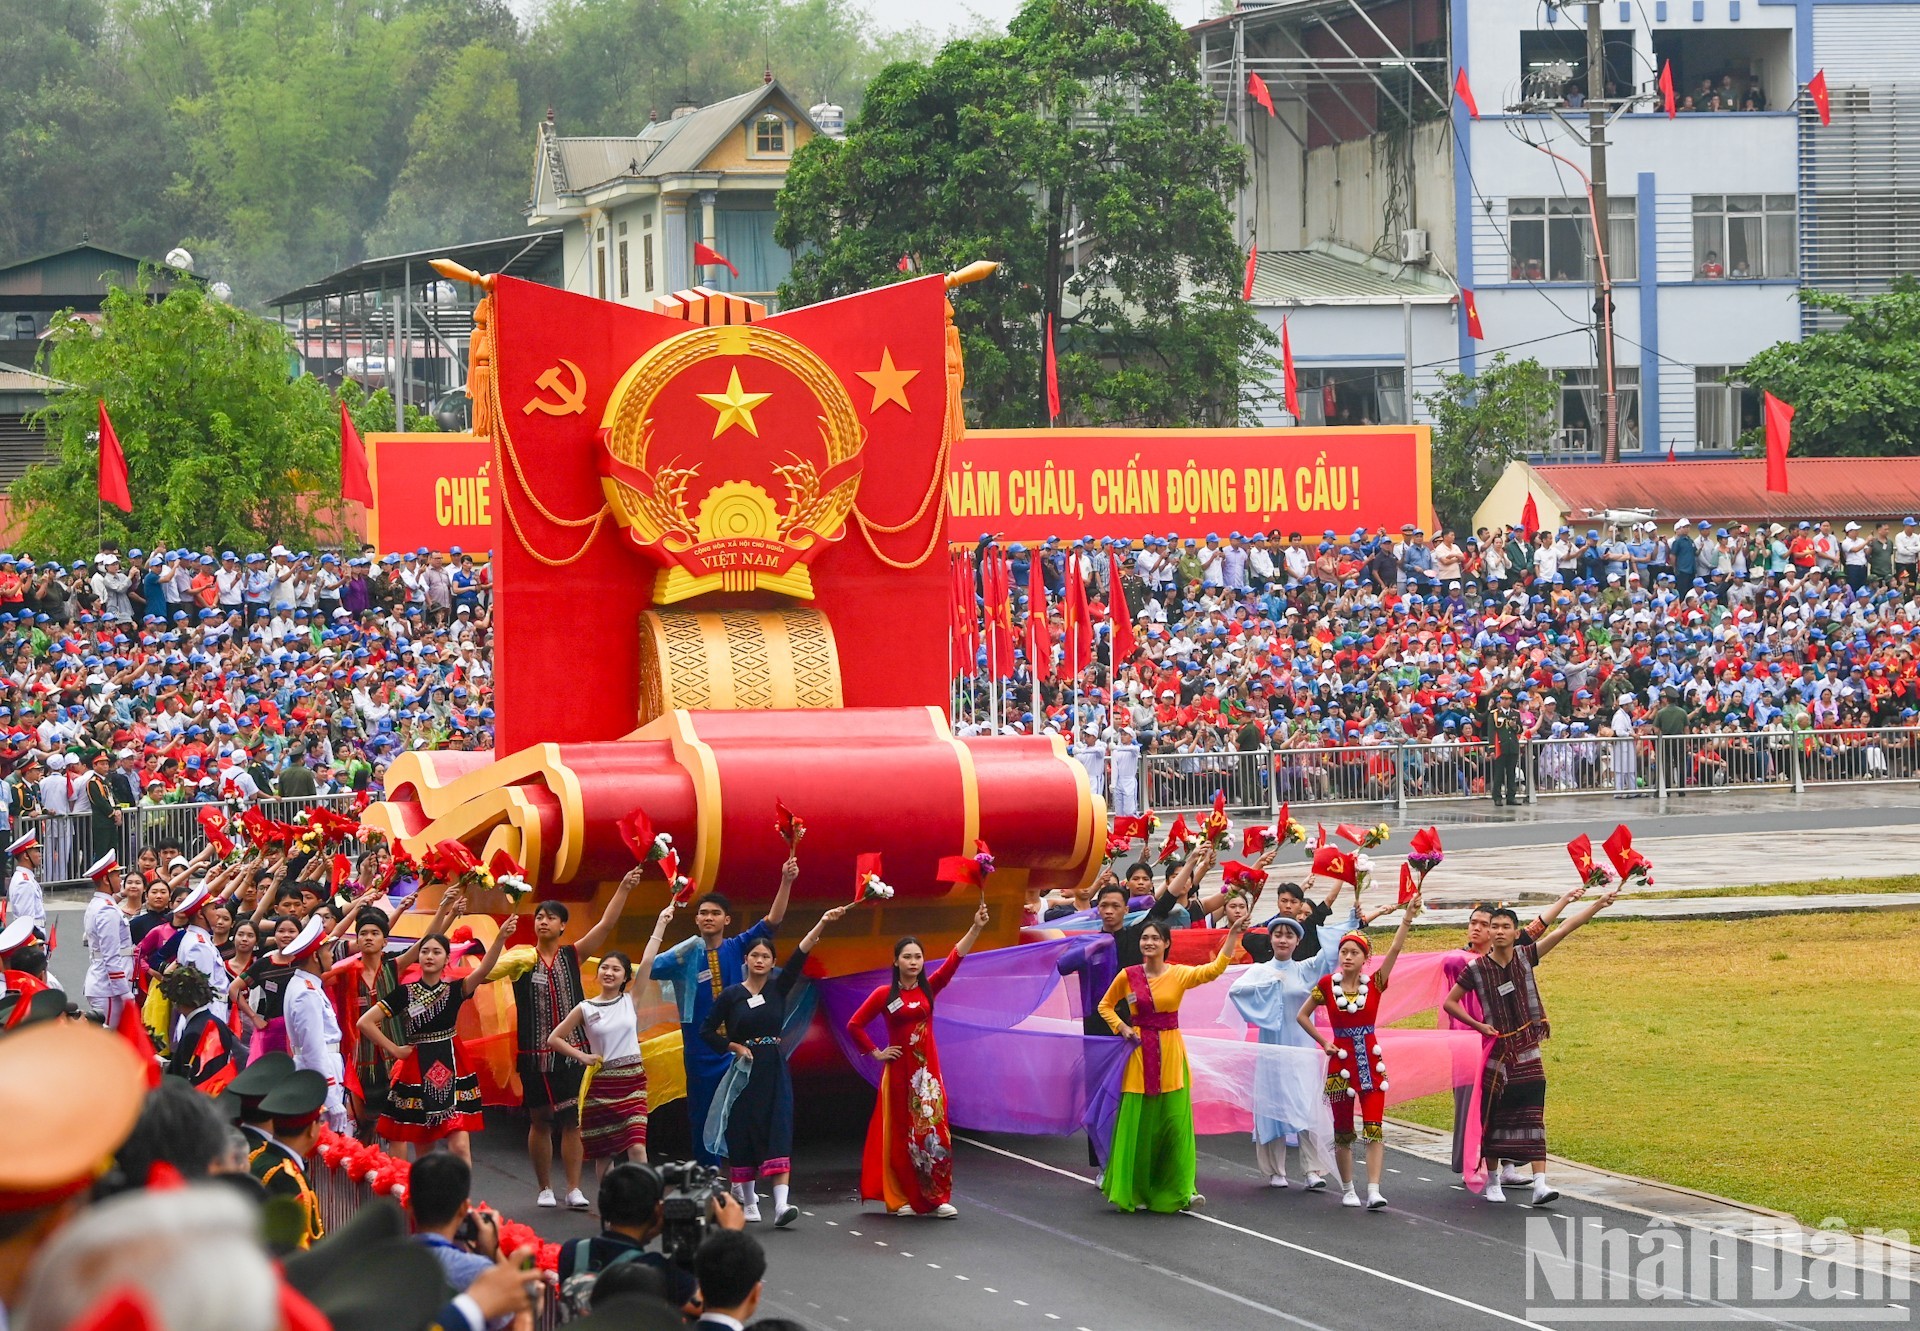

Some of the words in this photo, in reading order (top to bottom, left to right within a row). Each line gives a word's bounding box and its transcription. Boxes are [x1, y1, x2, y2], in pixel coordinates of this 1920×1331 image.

[435, 461, 492, 526] CHIẾ
[946, 461, 1001, 517] NĂM
[1008, 459, 1084, 521] CHÂU,
[1091, 452, 1160, 516] CHẤN
[1166, 459, 1237, 524] ĐỘNG
[1243, 467, 1289, 523] ĐỊA
[695, 547, 711, 555] CỘNG
[713, 542, 725, 550] HÒA
[739, 540, 750, 548] HỘI
[751, 540, 765, 548] CHỦ
[766, 544, 784, 553] NGHĨA
[701, 551, 737, 568] VIỆT
[742, 553, 779, 567] NAM
